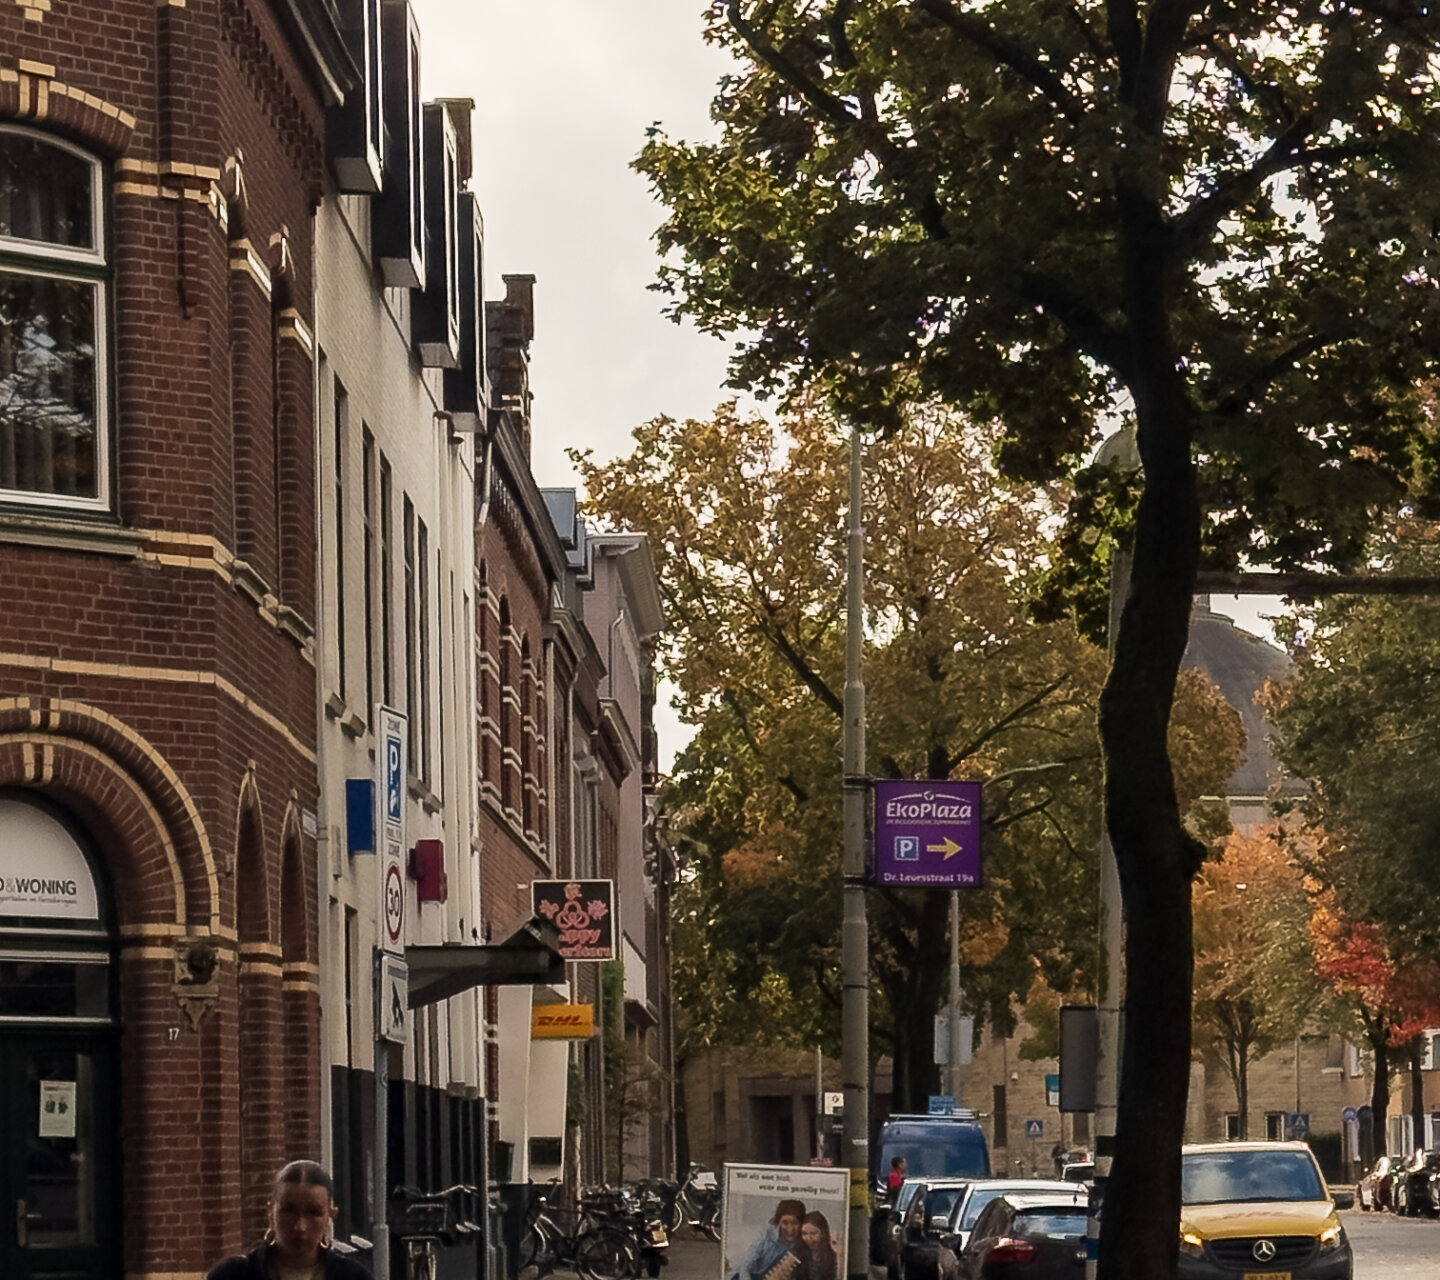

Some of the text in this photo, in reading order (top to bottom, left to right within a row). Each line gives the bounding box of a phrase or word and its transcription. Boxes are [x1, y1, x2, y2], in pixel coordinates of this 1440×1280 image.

[886, 803, 972, 818] EkoPlaza
[900, 840, 913, 858] P
[389, 887, 399, 917] 30
[558, 928, 601, 944] appy
[537, 1016, 582, 1026] DHL
[169, 1027, 180, 1040] 17
